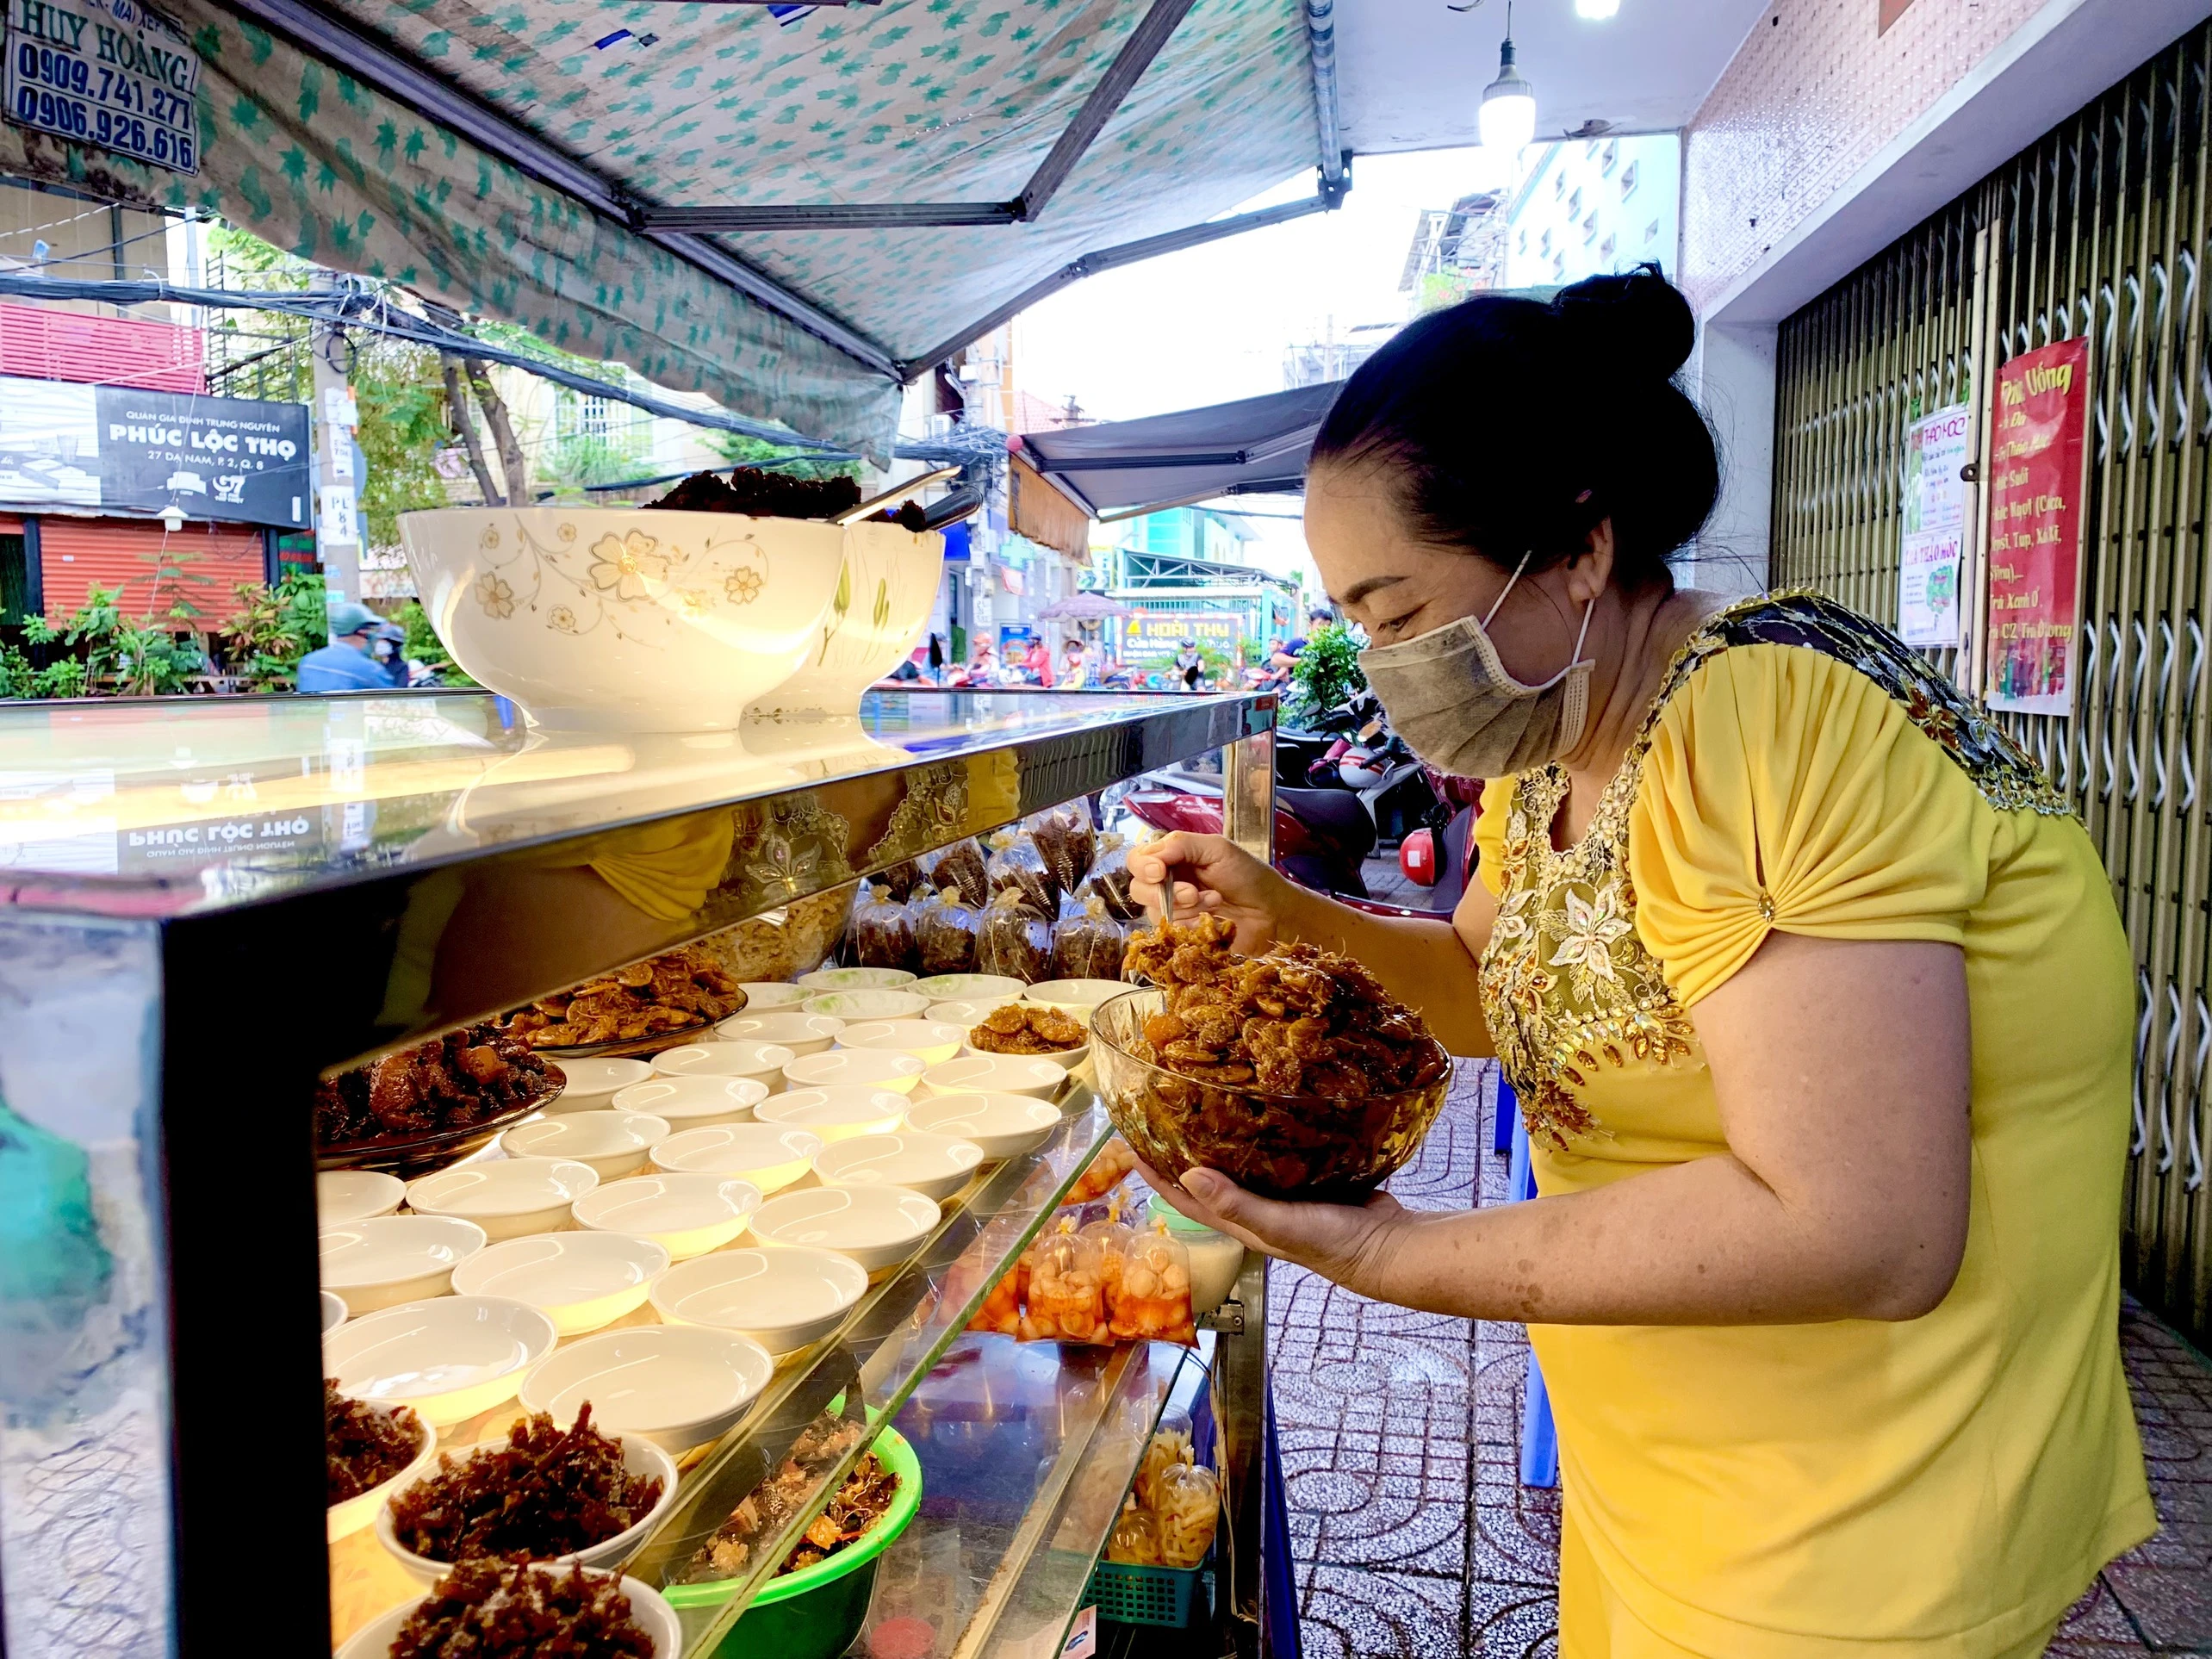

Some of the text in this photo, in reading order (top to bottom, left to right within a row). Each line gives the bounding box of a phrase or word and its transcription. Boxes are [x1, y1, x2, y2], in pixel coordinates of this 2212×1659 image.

[19, 0, 88, 52] HUY
[19, 43, 190, 129] 0909.741.277
[17, 86, 192, 168] 0906.926.616
[109, 423, 297, 461] PHÚC LỘC THỌ
[158, 413, 177, 423] GIA
[206, 418, 238, 429] TRUNG
[239, 420, 281, 433] NGUYÊN
[147, 450, 161, 460] 27
[1146, 619, 1189, 637] HOÀI
